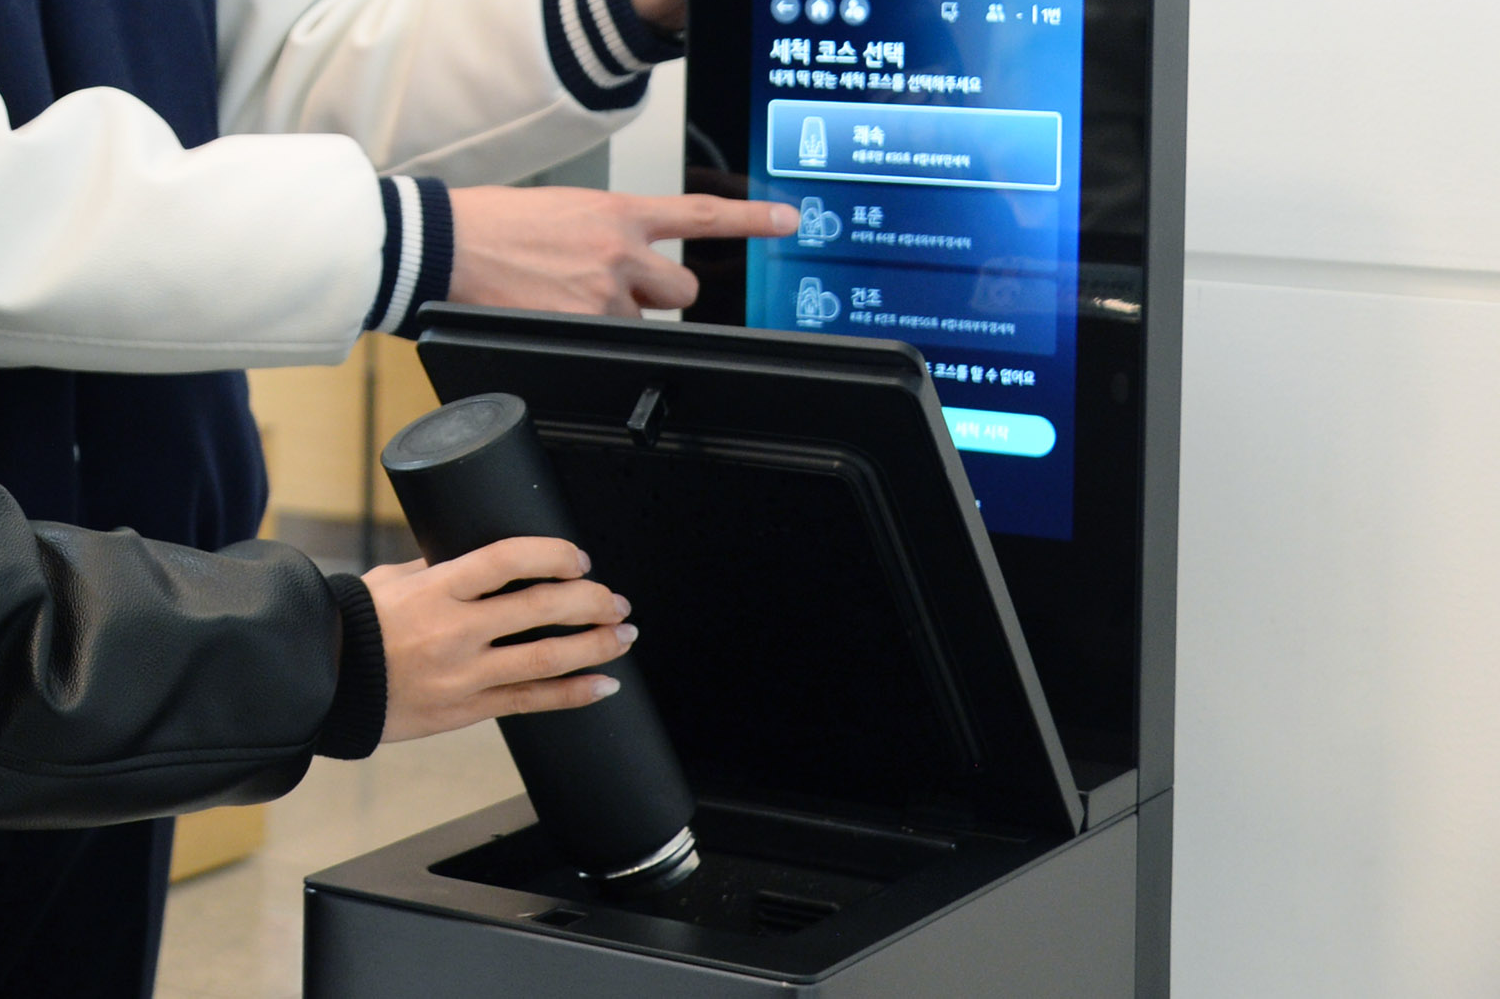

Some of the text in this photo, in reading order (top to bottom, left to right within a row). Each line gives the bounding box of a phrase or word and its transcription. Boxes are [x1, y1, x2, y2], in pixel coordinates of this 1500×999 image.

[769, 37, 906, 70] 세척 코스 선택
[839, 71, 866, 91] 세척
[866, 72, 905, 93] 코스를
[851, 124, 886, 147] 쾌속
[851, 205, 885, 229] 표준
[850, 286, 884, 309] 건조
[934, 362, 969, 383] 코스를
[1000, 367, 1037, 387] 없어요
